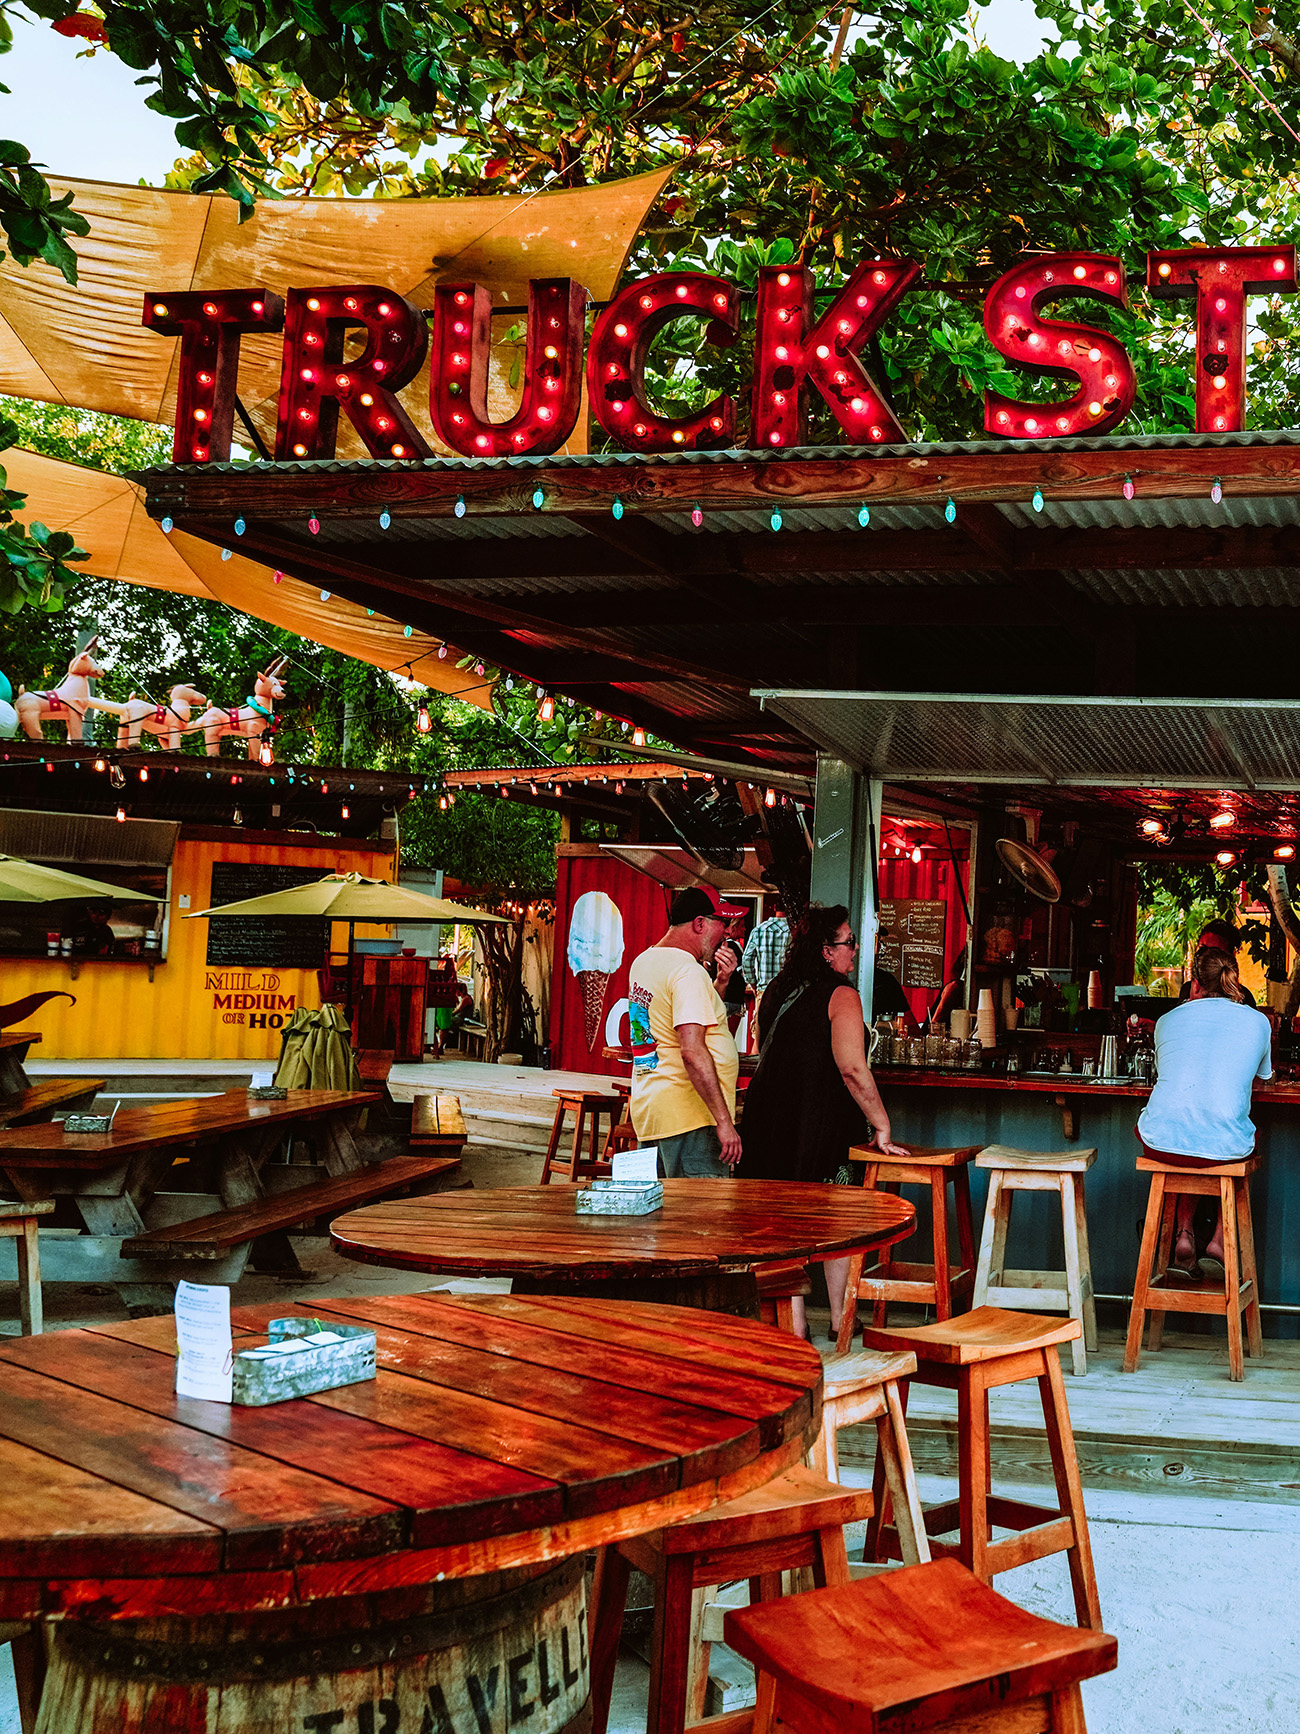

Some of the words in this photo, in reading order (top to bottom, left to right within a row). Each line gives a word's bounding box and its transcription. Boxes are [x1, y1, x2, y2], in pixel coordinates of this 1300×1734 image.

[142, 258, 923, 464] TRUCK
[204, 972, 281, 992] MILD
[213, 993, 296, 1011] MEDIUM
[222, 1012, 245, 1025] OR
